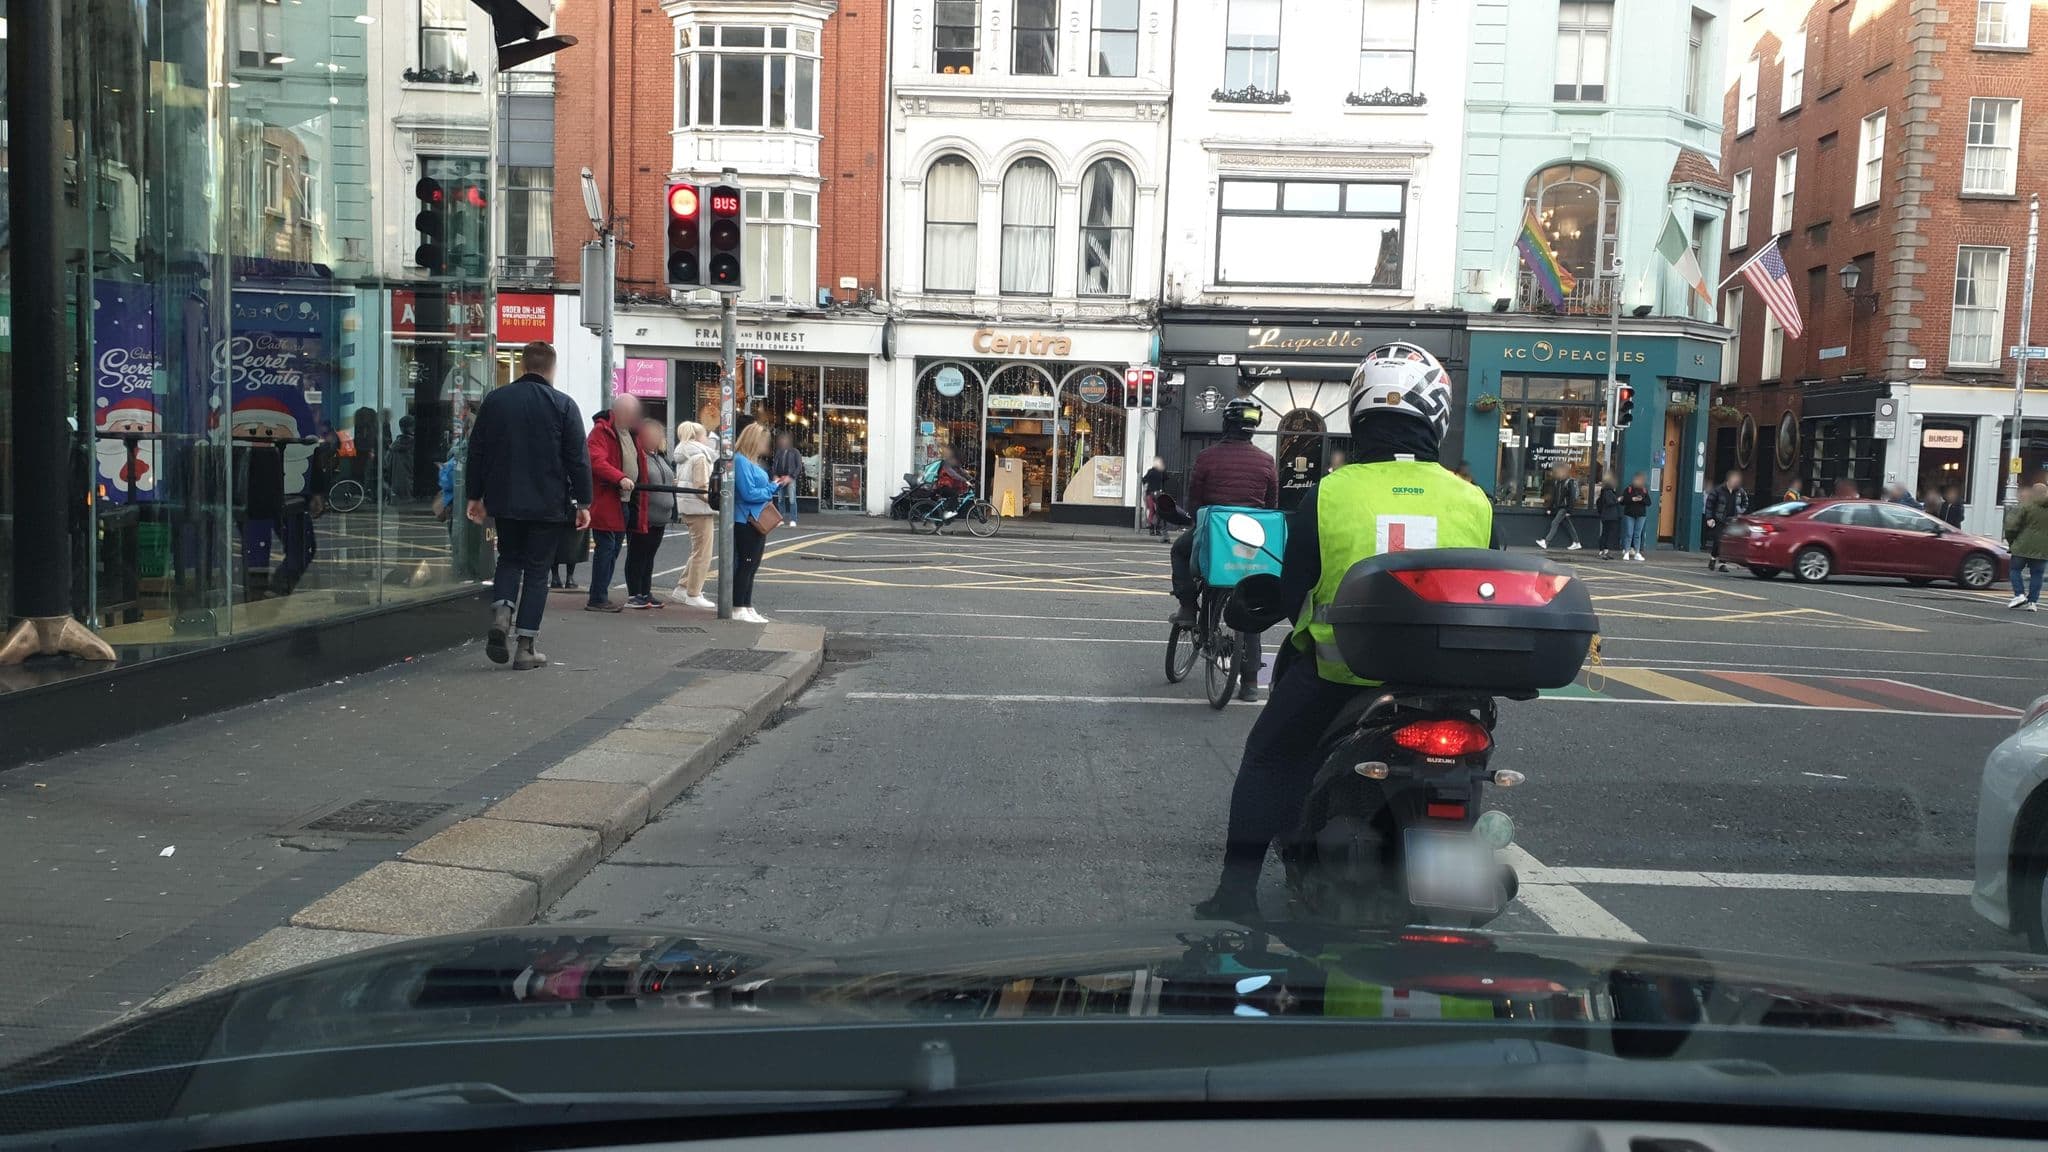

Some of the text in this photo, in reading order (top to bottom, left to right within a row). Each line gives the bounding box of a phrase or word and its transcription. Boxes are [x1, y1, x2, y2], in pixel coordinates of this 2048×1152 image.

[714, 197, 737, 210] BUS
[502, 305, 521, 314] ORDER
[695, 328, 721, 339] FRA
[756, 331, 805, 343] HONEST
[971, 327, 1072, 357] Centra
[210, 336, 297, 384] Secret
[1504, 347, 1527, 359] KC
[122, 375, 153, 393] San
[247, 368, 303, 391] Santa
[1928, 435, 1958, 443] BUNSEN
